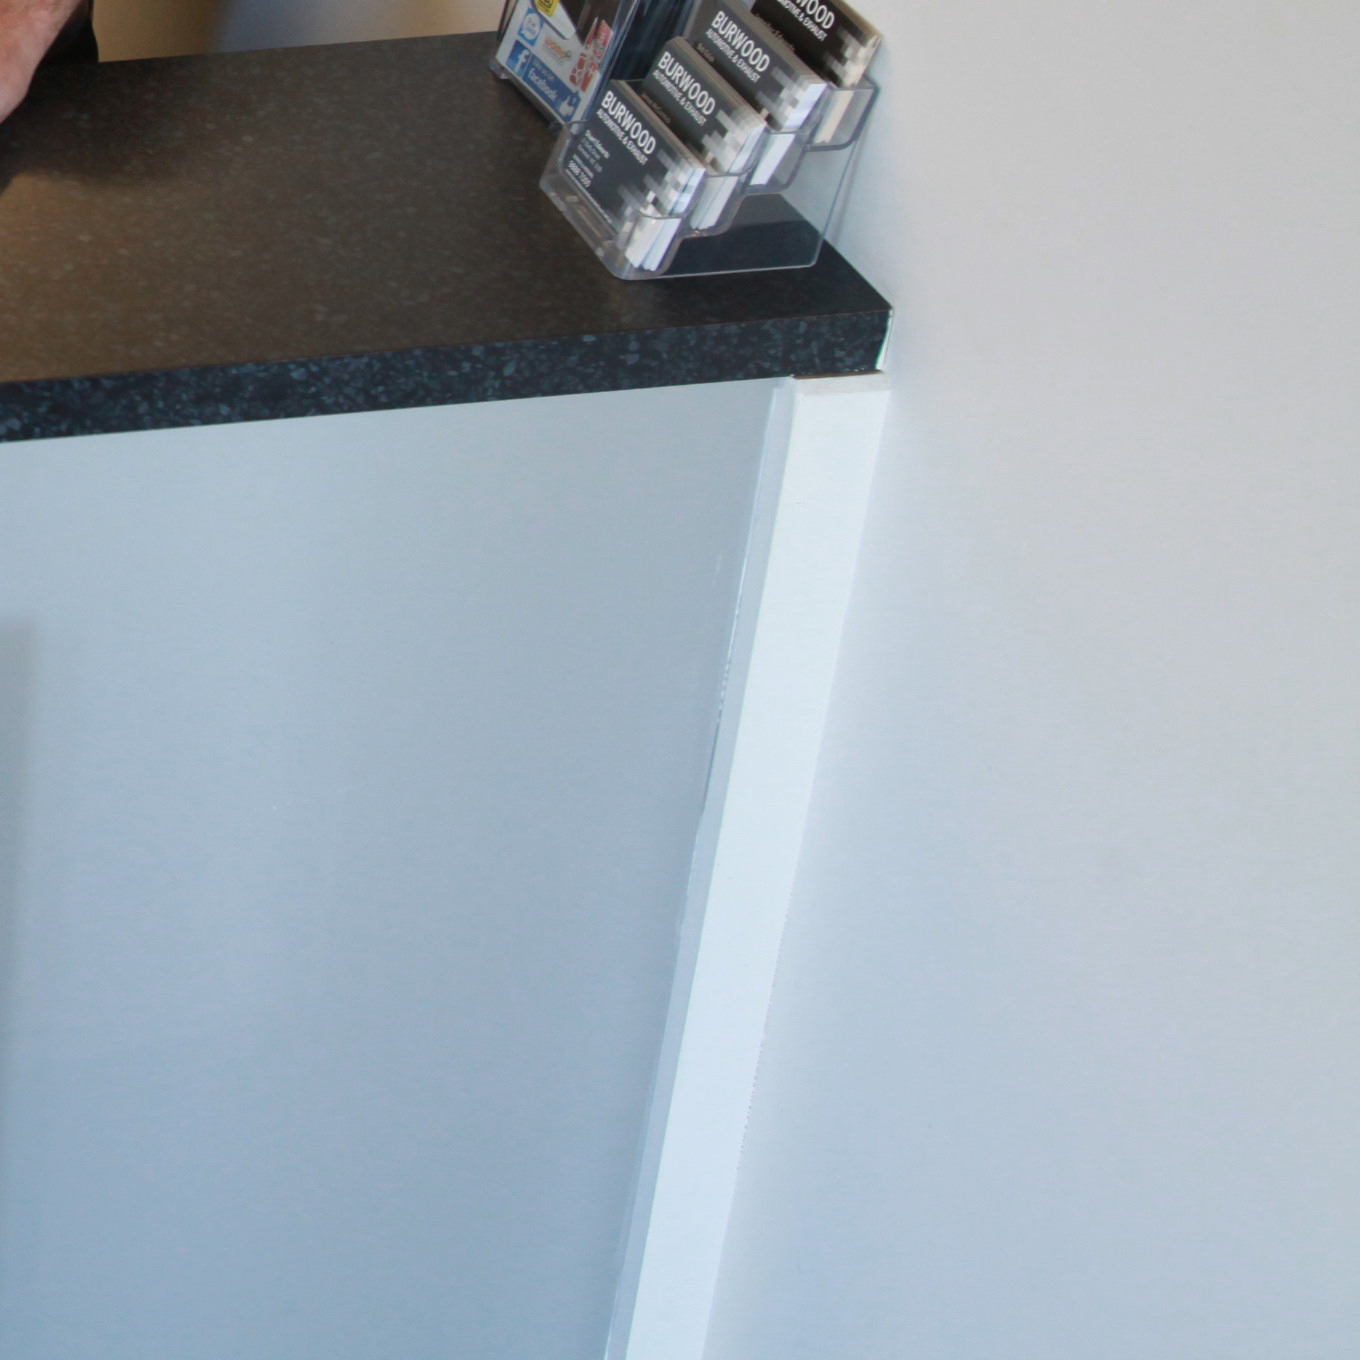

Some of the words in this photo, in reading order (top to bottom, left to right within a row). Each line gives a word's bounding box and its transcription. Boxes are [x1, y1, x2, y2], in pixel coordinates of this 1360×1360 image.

[711, 10, 770, 72] BURWOOD
[658, 51, 716, 115] BURWOOD
[601, 90, 656, 155] BURWOOD
